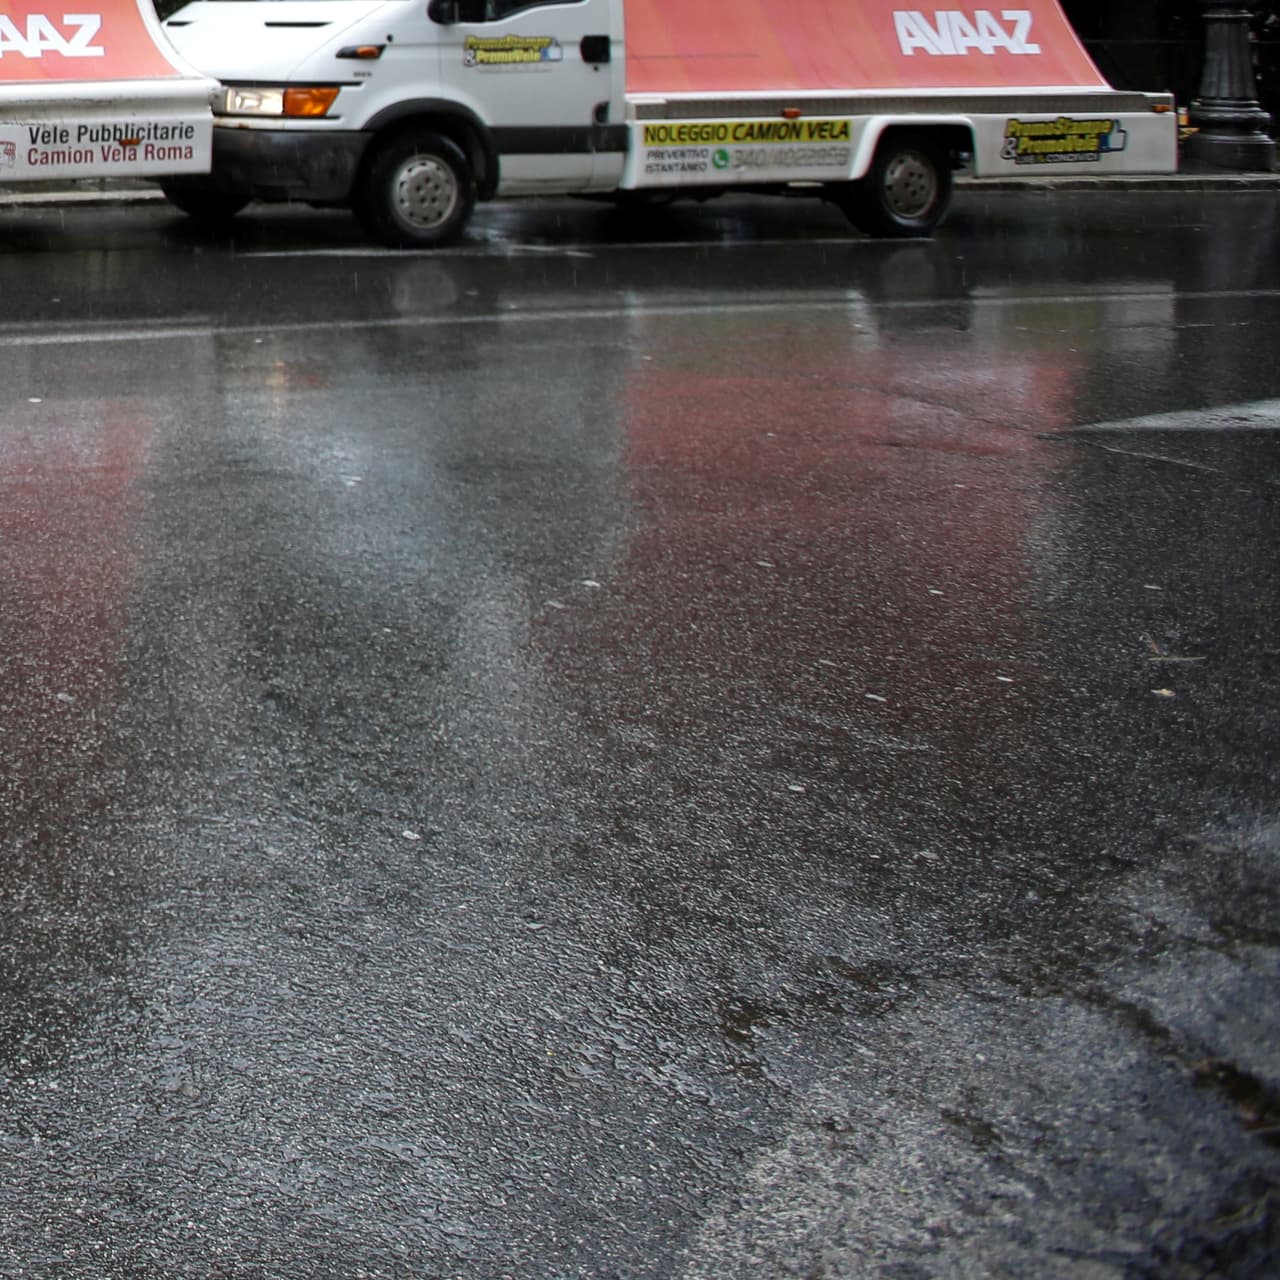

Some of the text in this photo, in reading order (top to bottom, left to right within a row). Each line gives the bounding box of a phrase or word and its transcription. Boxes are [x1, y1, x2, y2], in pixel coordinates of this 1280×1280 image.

[892, 10, 1042, 56] AVAAZ
[28, 122, 195, 144] Vele Pubblicitarie
[644, 121, 850, 142] NOLEGGIO CAMION VELA
[27, 143, 193, 166] Camion Vela Roma
[647, 148, 709, 161] PREVENTIVO
